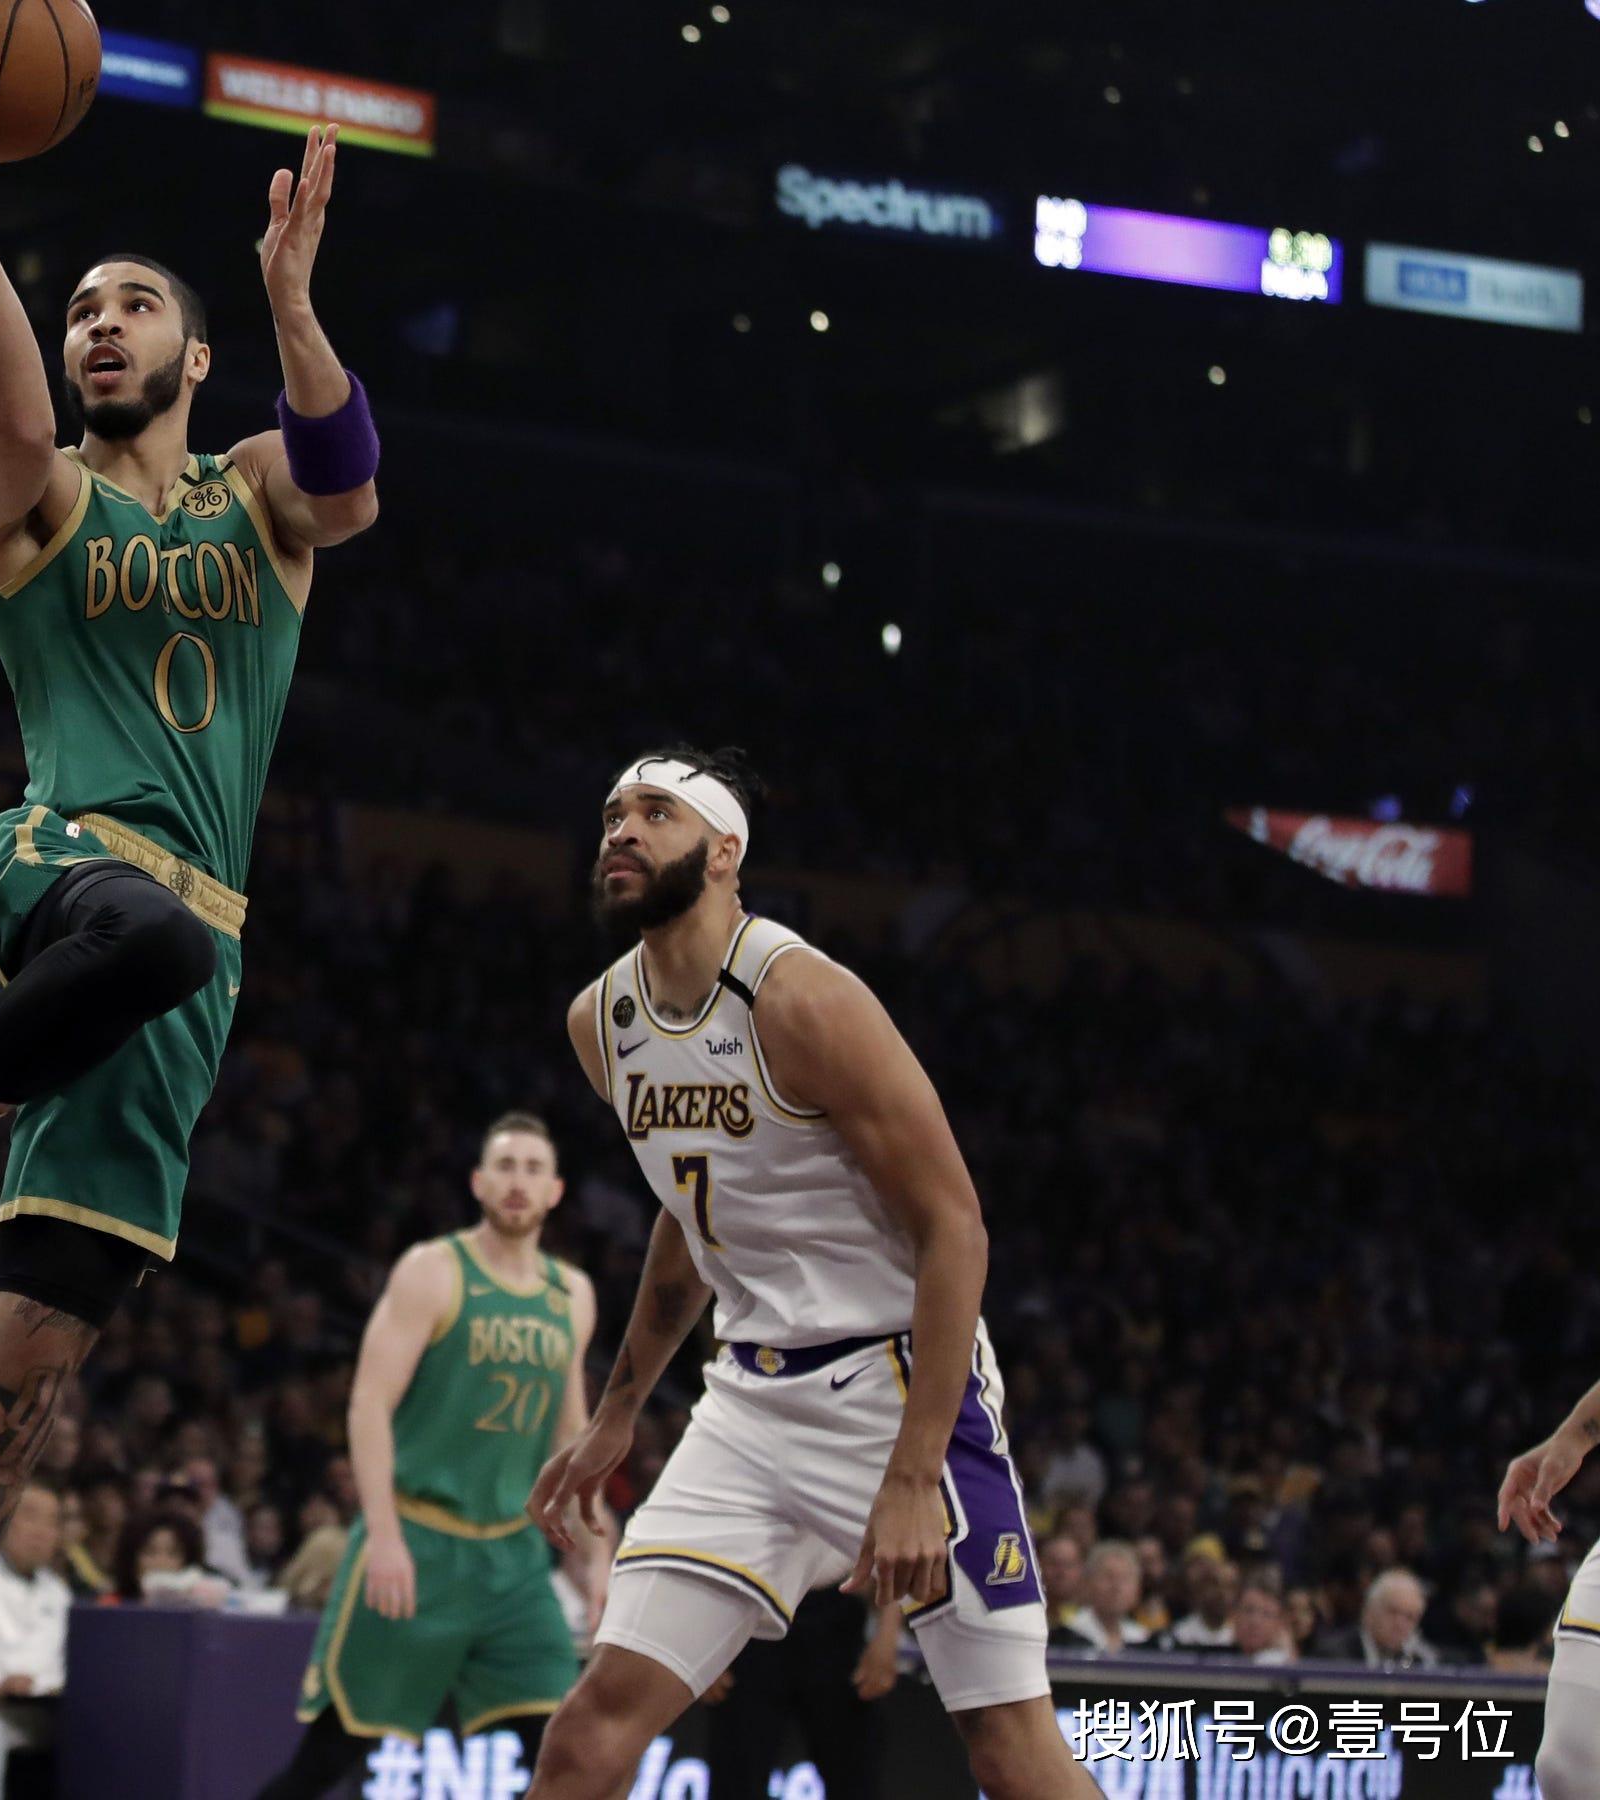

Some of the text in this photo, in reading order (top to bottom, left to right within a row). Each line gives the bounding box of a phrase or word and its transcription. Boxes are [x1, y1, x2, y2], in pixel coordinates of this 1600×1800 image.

[776, 164, 992, 239] Spectrum
[85, 534, 262, 628] BOTON
[153, 632, 217, 734] 0
[705, 1037, 743, 1056] wish
[626, 1072, 754, 1141] LAKERS
[671, 1153, 722, 1250] 7
[474, 1371, 552, 1436] 20
